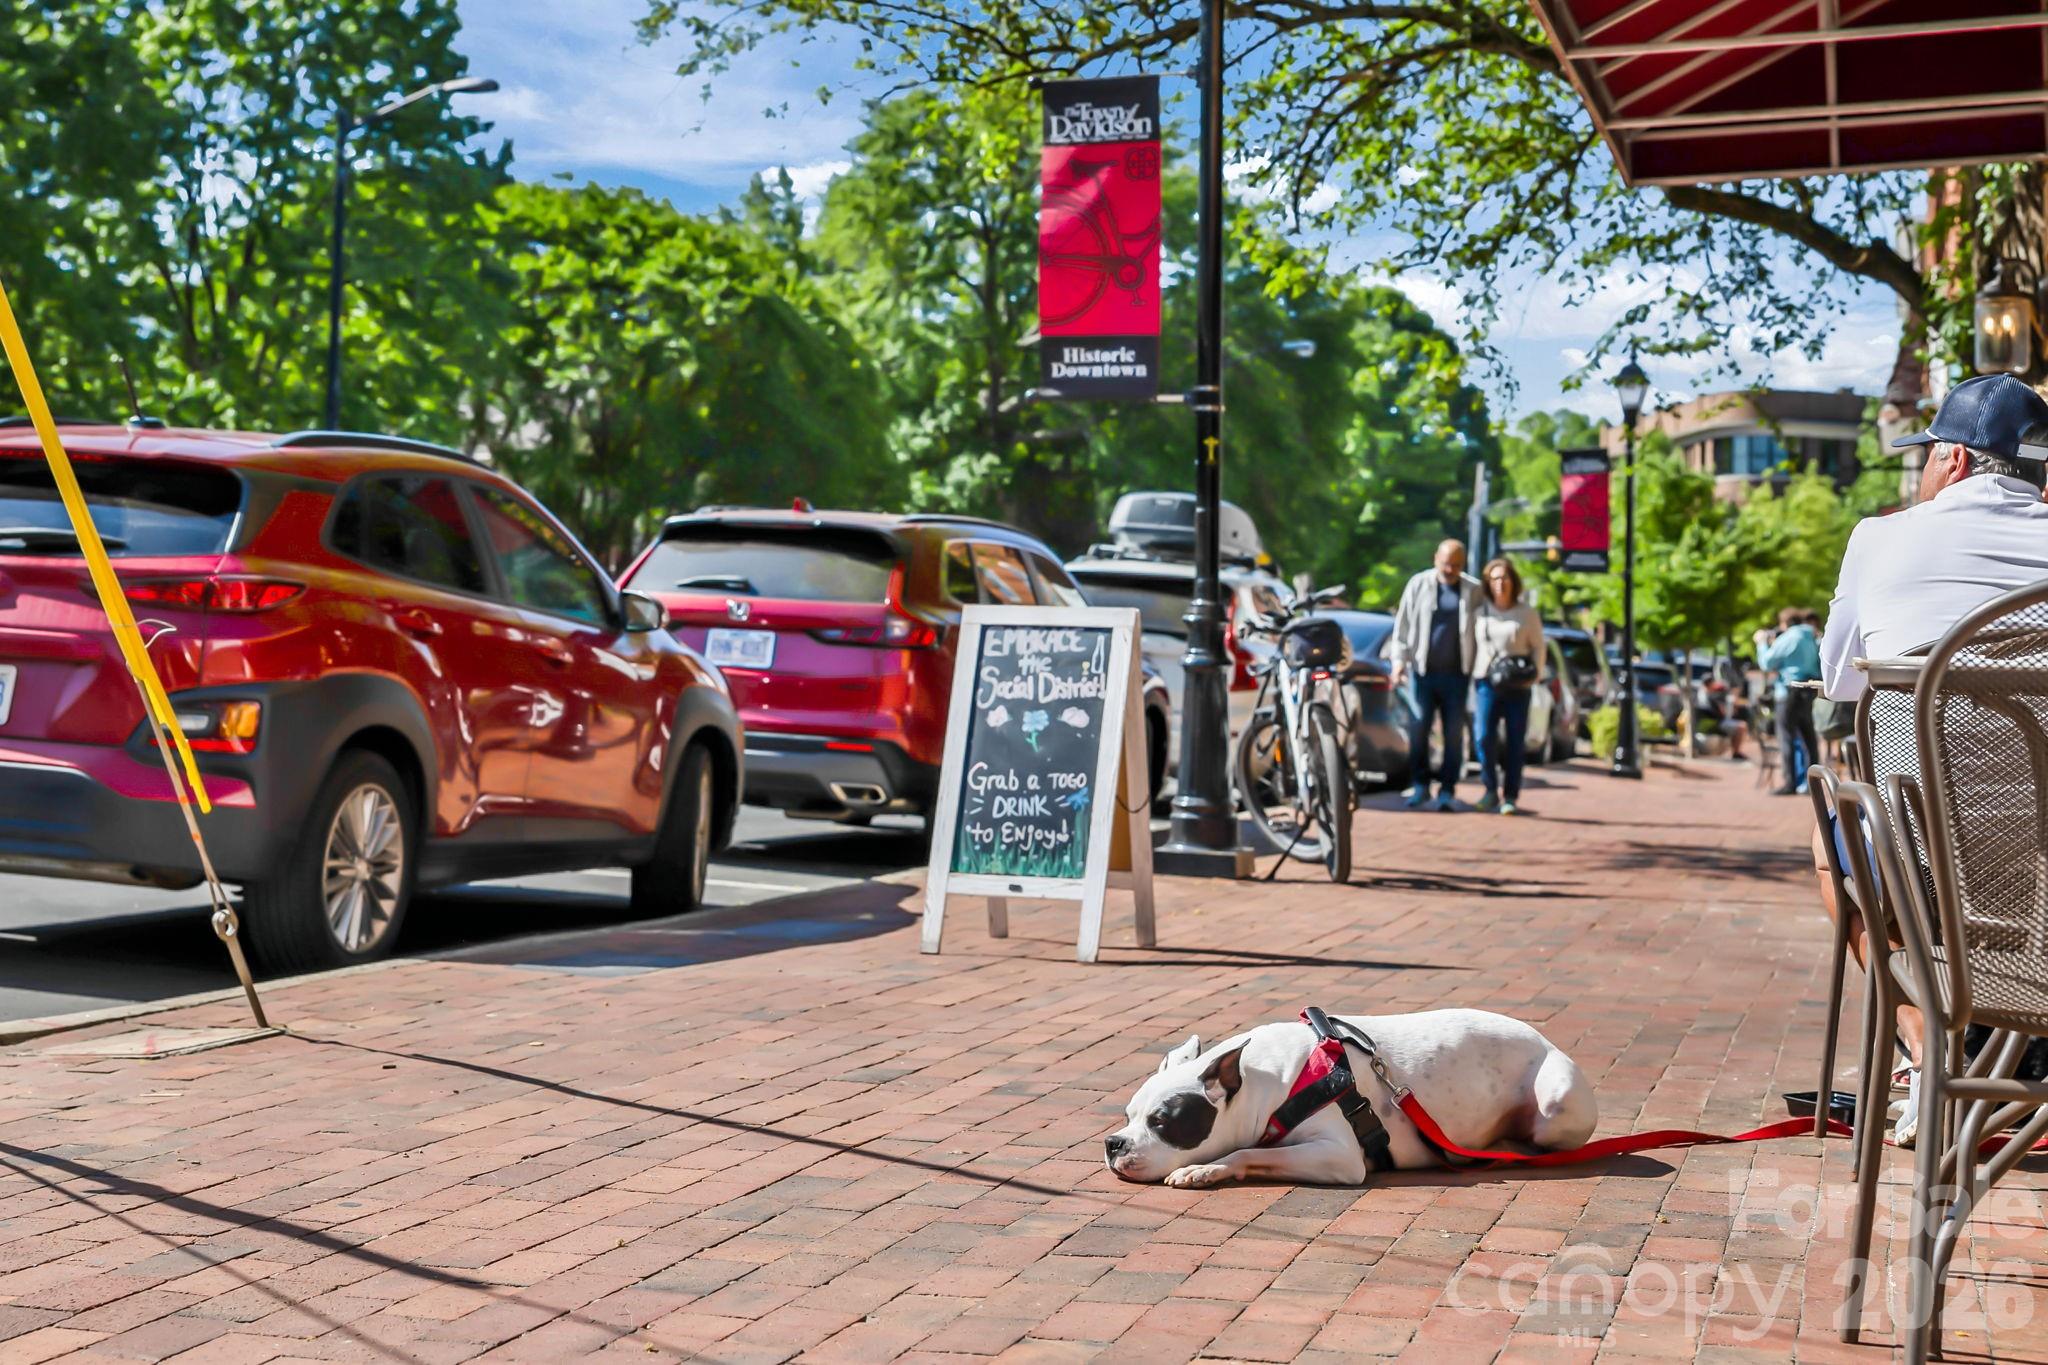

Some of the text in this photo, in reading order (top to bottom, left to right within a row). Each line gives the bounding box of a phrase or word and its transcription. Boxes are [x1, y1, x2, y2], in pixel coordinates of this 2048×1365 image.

[1075, 102, 1125, 121] Town
[1050, 115, 1152, 139] Davidson
[1063, 346, 1136, 363] Historic
[1051, 362, 1148, 378] Downtown
[984, 627, 1087, 657] EMBRACE
[977, 666, 1106, 709] Social District!
[967, 761, 1087, 796] Grab a TOGO
[992, 794, 1052, 818] DRINK
[971, 822, 994, 843] to
